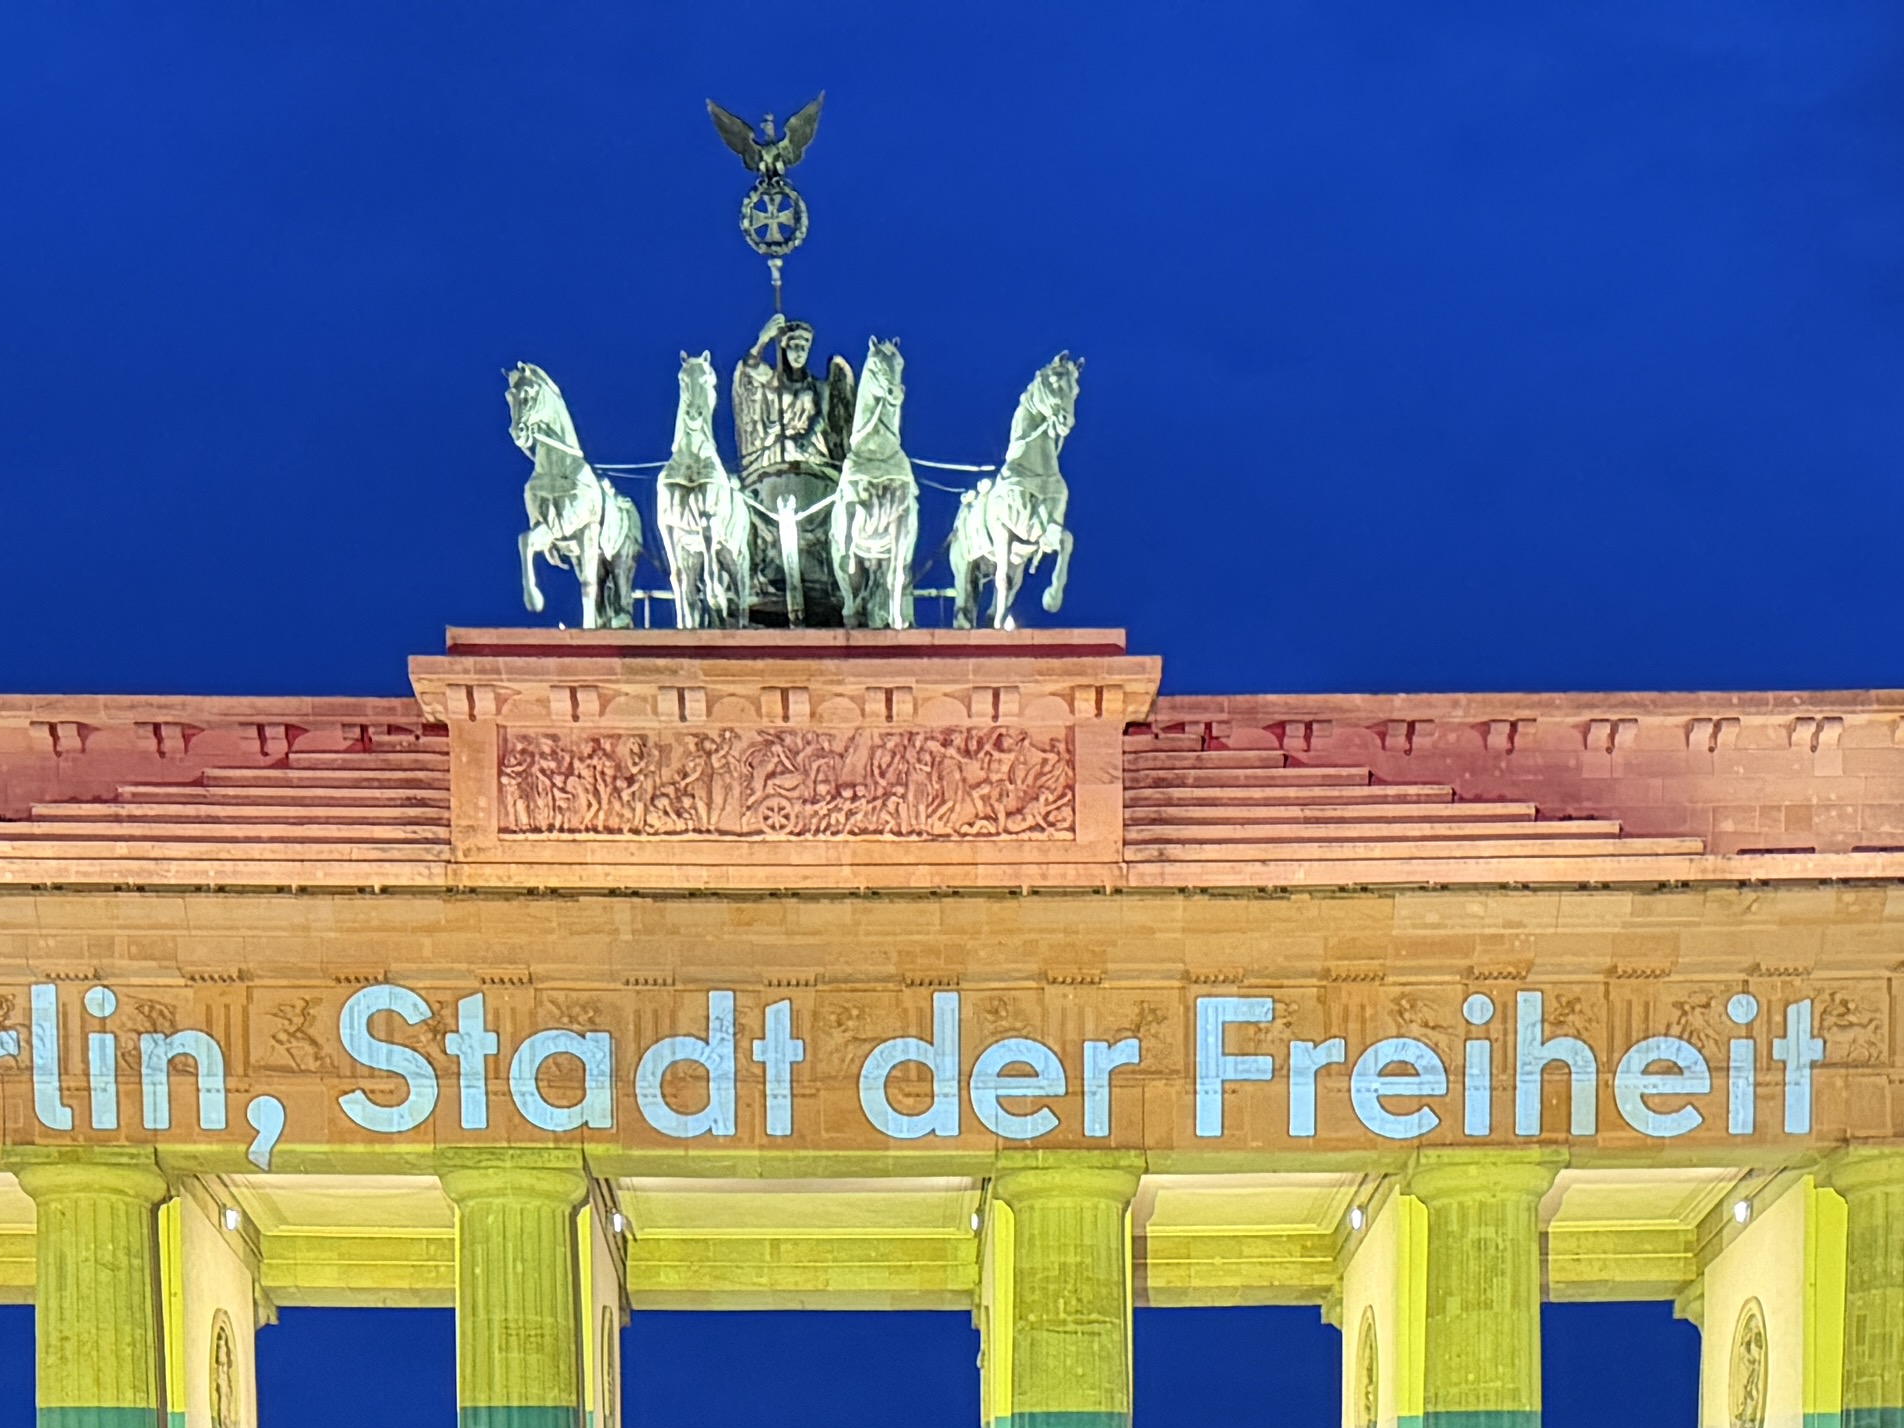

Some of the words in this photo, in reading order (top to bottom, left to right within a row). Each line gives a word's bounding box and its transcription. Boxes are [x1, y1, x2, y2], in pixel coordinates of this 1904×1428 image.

[340, 984, 804, 1139] Stadt
[860, 991, 1140, 1139] der
[1196, 991, 1824, 1139] Freiheit
